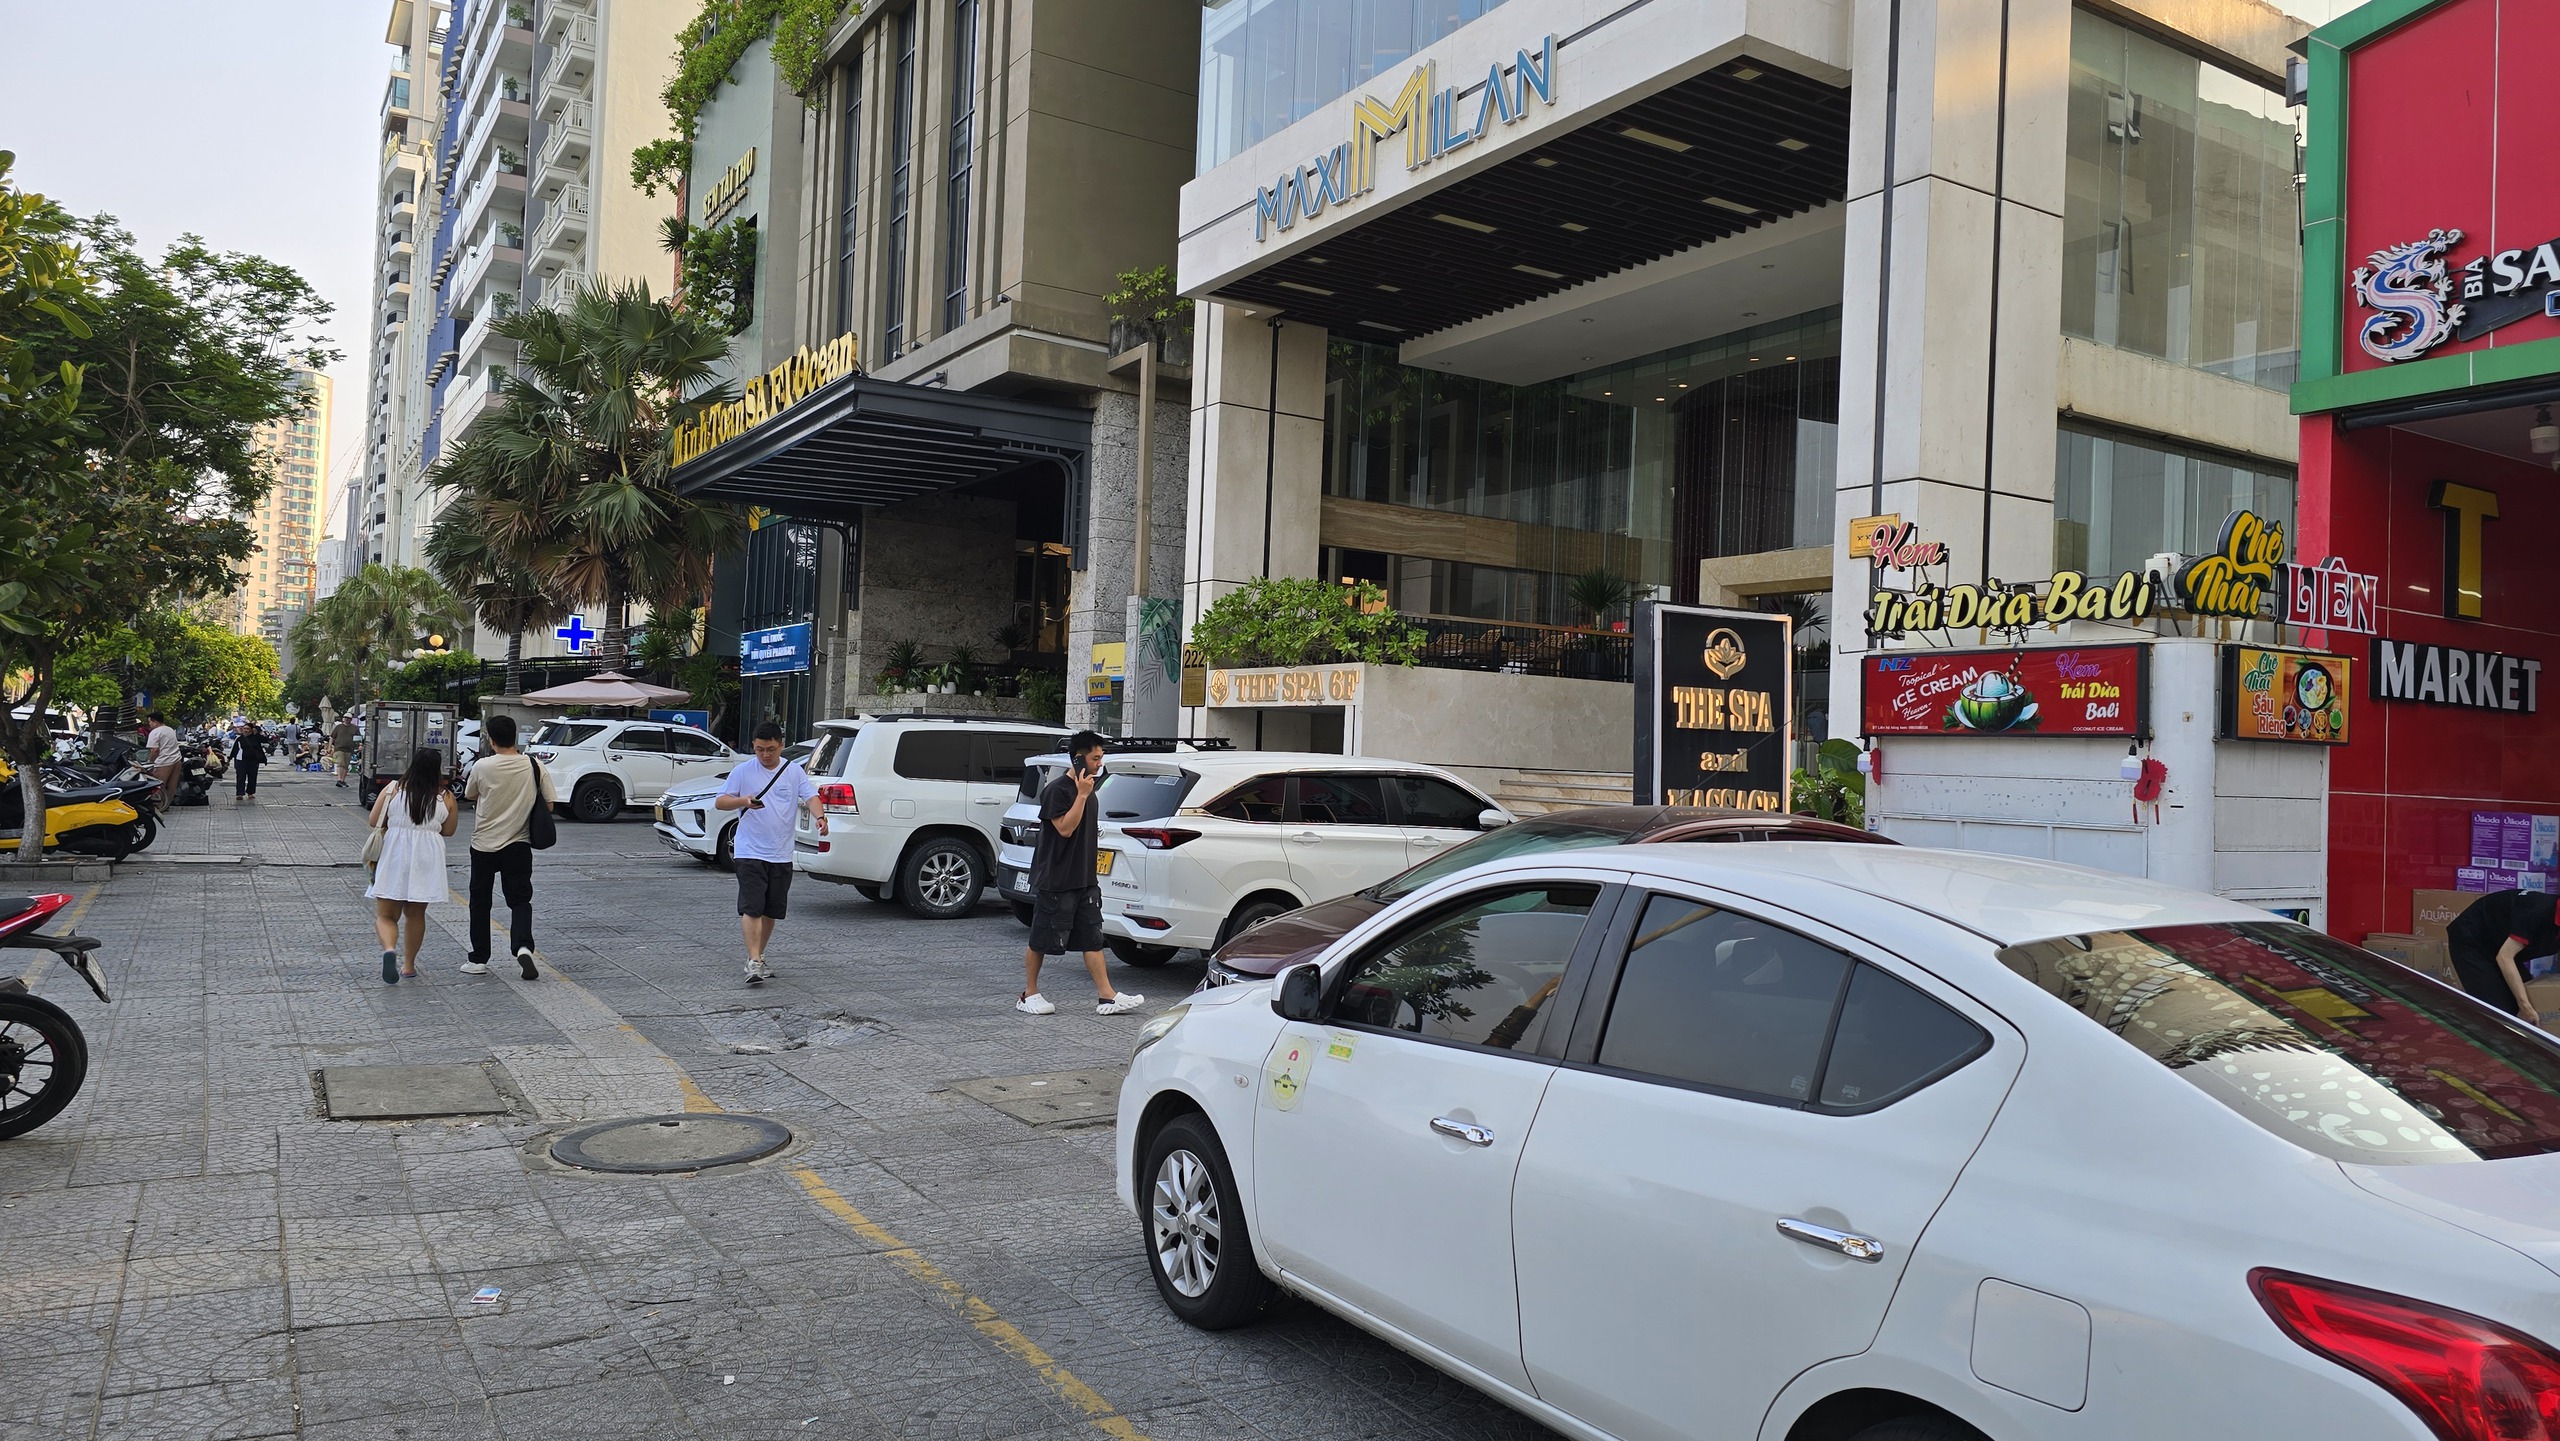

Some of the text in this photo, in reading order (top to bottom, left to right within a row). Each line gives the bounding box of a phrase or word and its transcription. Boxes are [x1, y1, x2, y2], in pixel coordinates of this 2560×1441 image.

[2464, 256, 2484, 298] BIA
[794, 331, 856, 401] Ocean
[1870, 522, 1942, 571] Kem
[2229, 510, 2284, 582] Chè
[2440, 482, 2500, 619] T
[1873, 570, 2151, 632] Trái Dừa Bali
[2186, 556, 2261, 615] Thái
[2286, 557, 2378, 634] LIÊN
[1184, 650, 1205, 668] 222
[2056, 653, 2101, 680] Kem
[2381, 640, 2541, 712] MARKET
[1235, 670, 1360, 702] THE SPA 6F
[1892, 666, 1978, 711] ICE CREAM
[2060, 681, 2120, 699] Trái Dừa
[1673, 686, 1775, 733] THE SPA
[2085, 702, 2119, 720] Bali
[2259, 715, 2287, 738] Riêng
[1700, 748, 1748, 773] and
[2419, 908, 2459, 922] AQUAFIN
